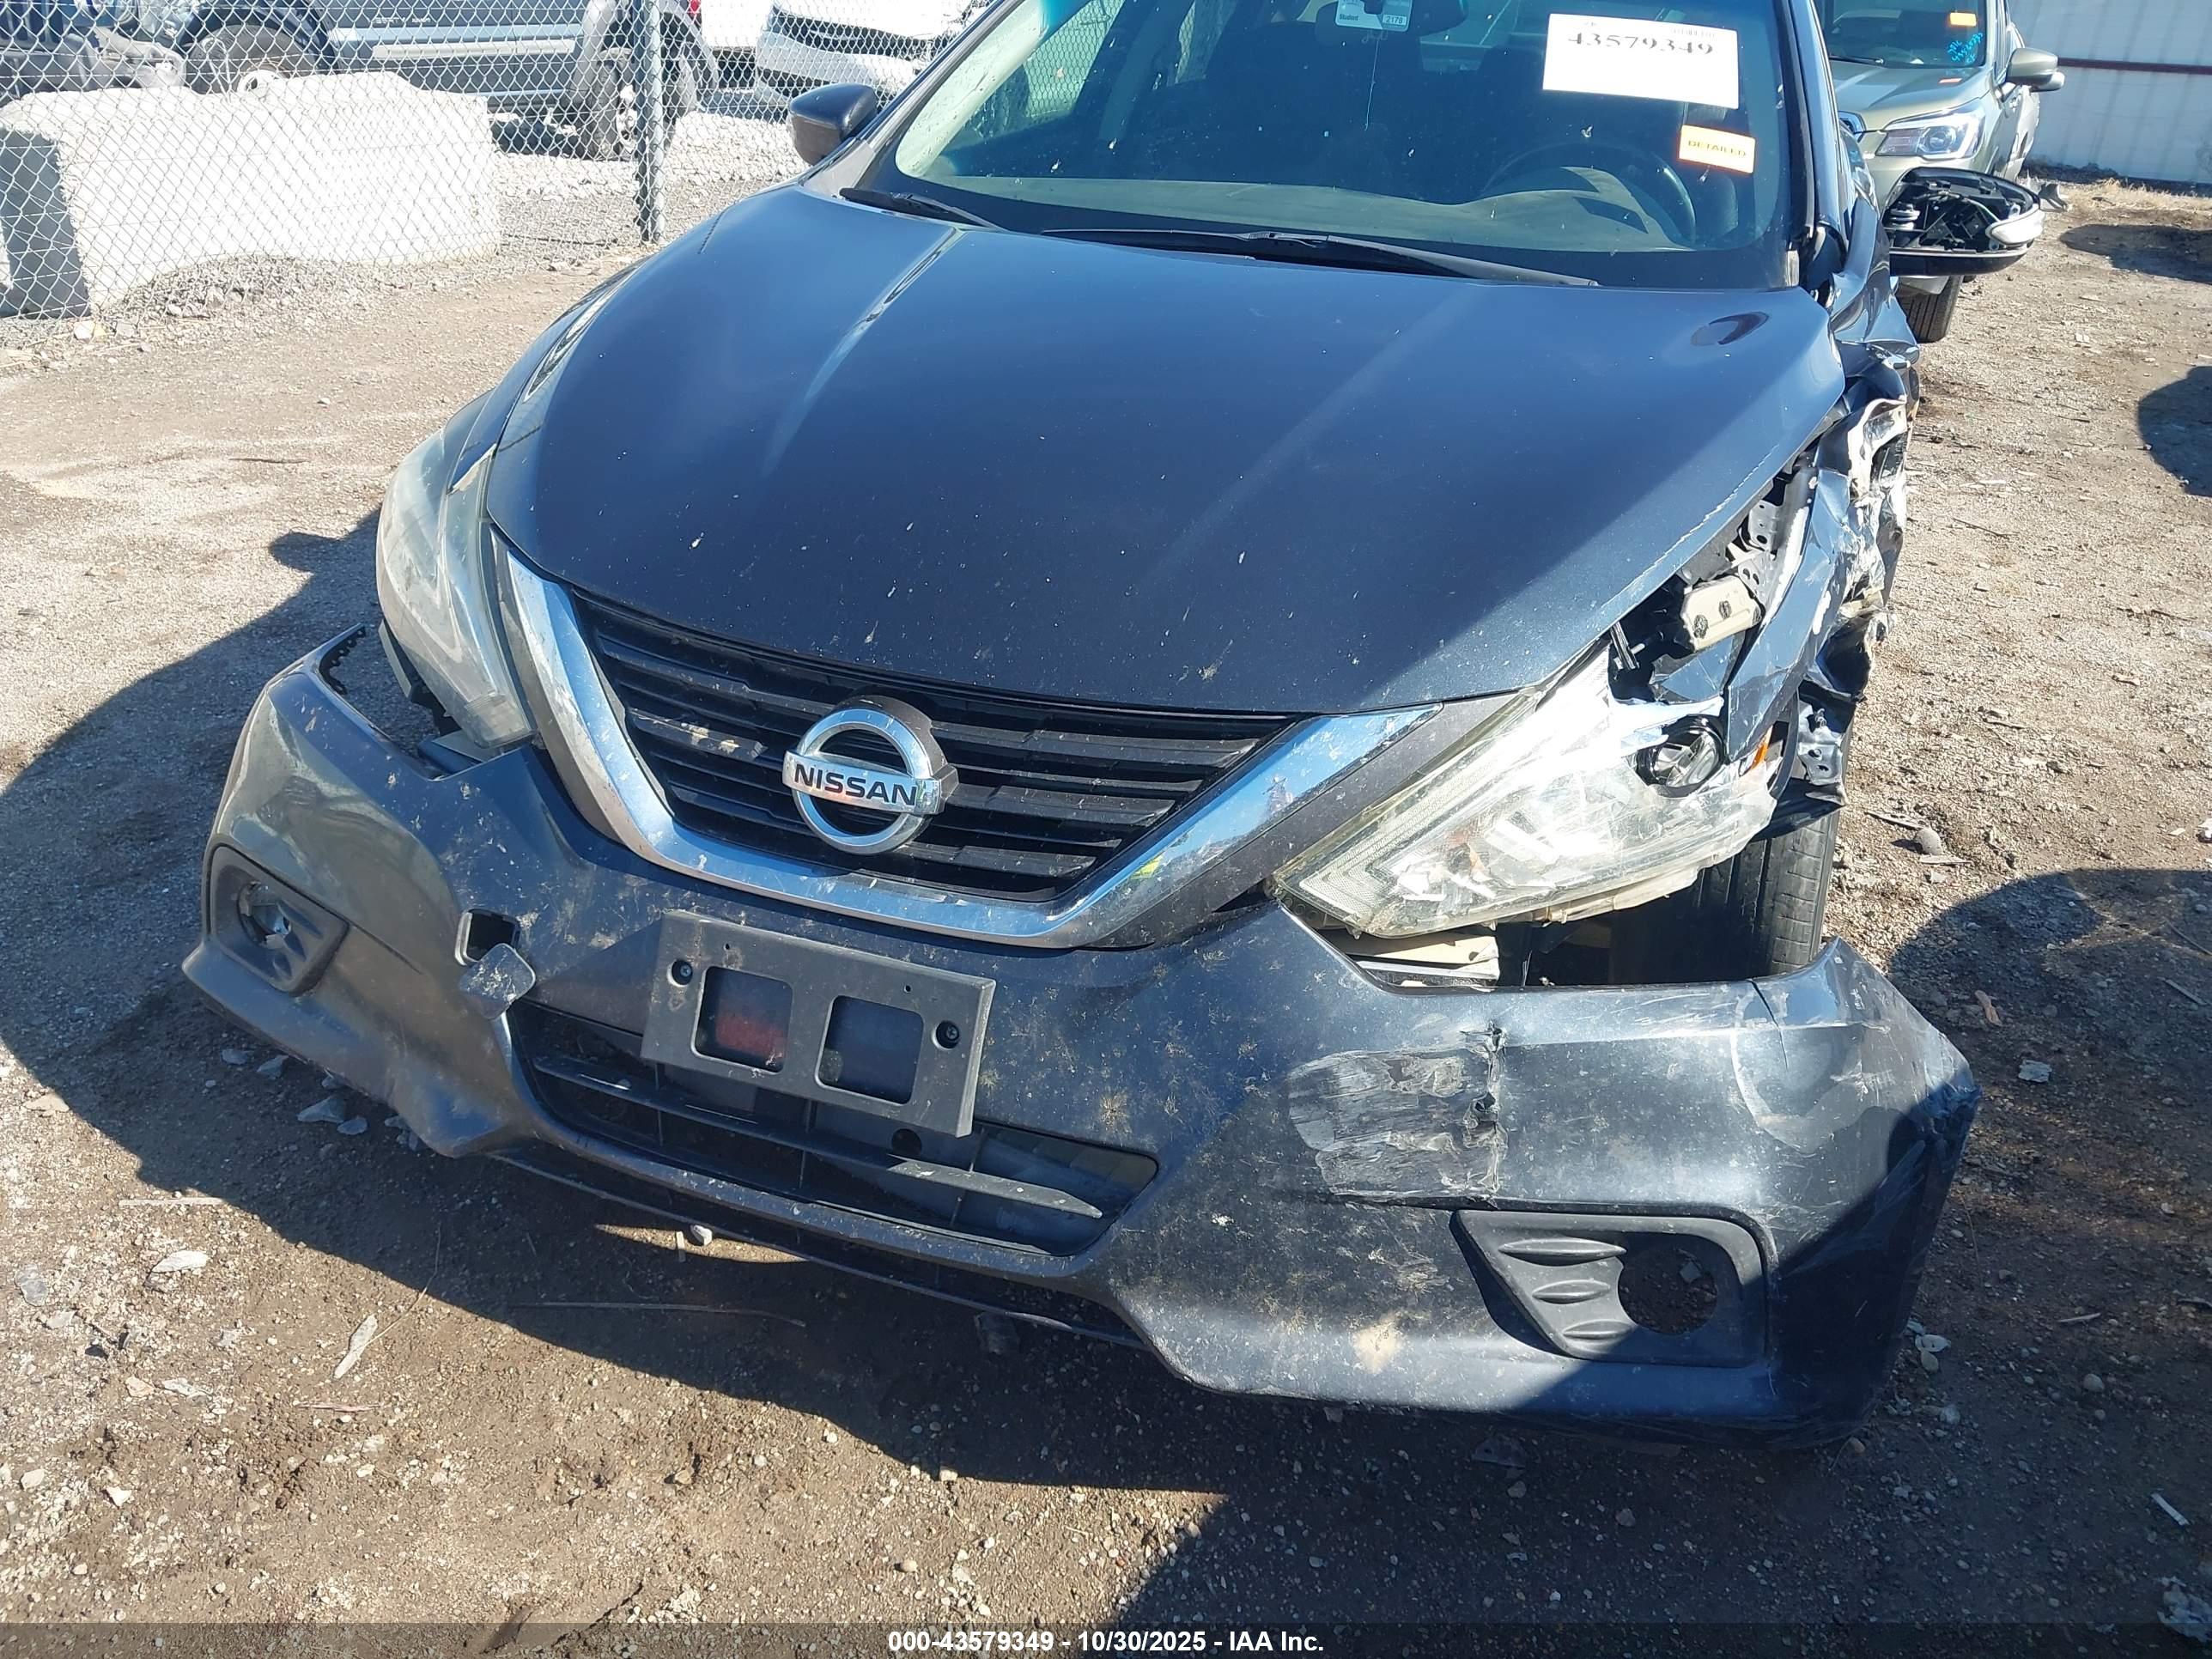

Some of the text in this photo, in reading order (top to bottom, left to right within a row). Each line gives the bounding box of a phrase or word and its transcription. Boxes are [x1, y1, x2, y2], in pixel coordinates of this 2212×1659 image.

[1340, 13, 1359, 21] Student
[1567, 32, 1714, 55] 43579349
[1687, 139, 1747, 158] DETAILED
[793, 763, 918, 806] NISSAN
